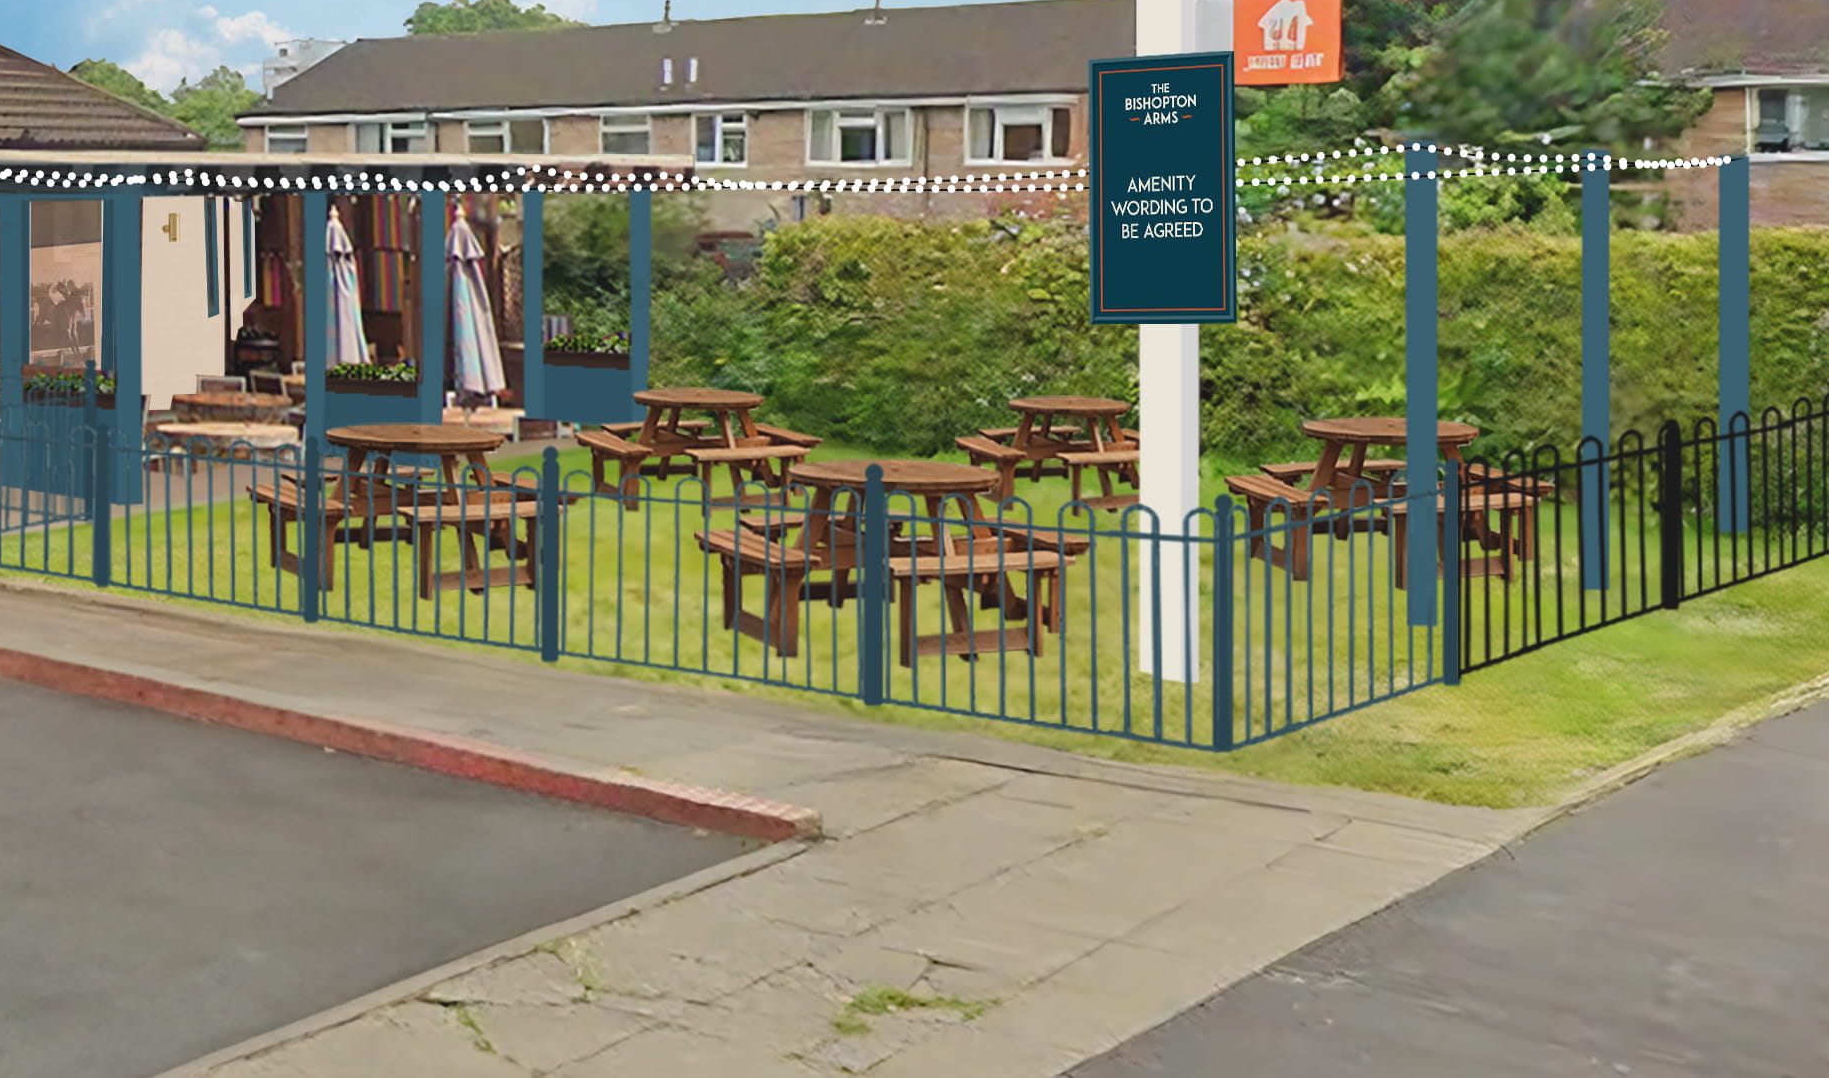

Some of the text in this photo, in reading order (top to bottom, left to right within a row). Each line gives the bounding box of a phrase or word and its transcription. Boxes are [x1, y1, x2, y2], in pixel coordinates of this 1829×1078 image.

[1151, 82, 1170, 94] THE
[1125, 94, 1197, 111] BISHOPTON
[1143, 111, 1179, 125] ARMS
[1127, 174, 1196, 193] AMENITY
[1111, 198, 1214, 217] WORDING TO
[1121, 222, 1203, 239] BE AGREED
